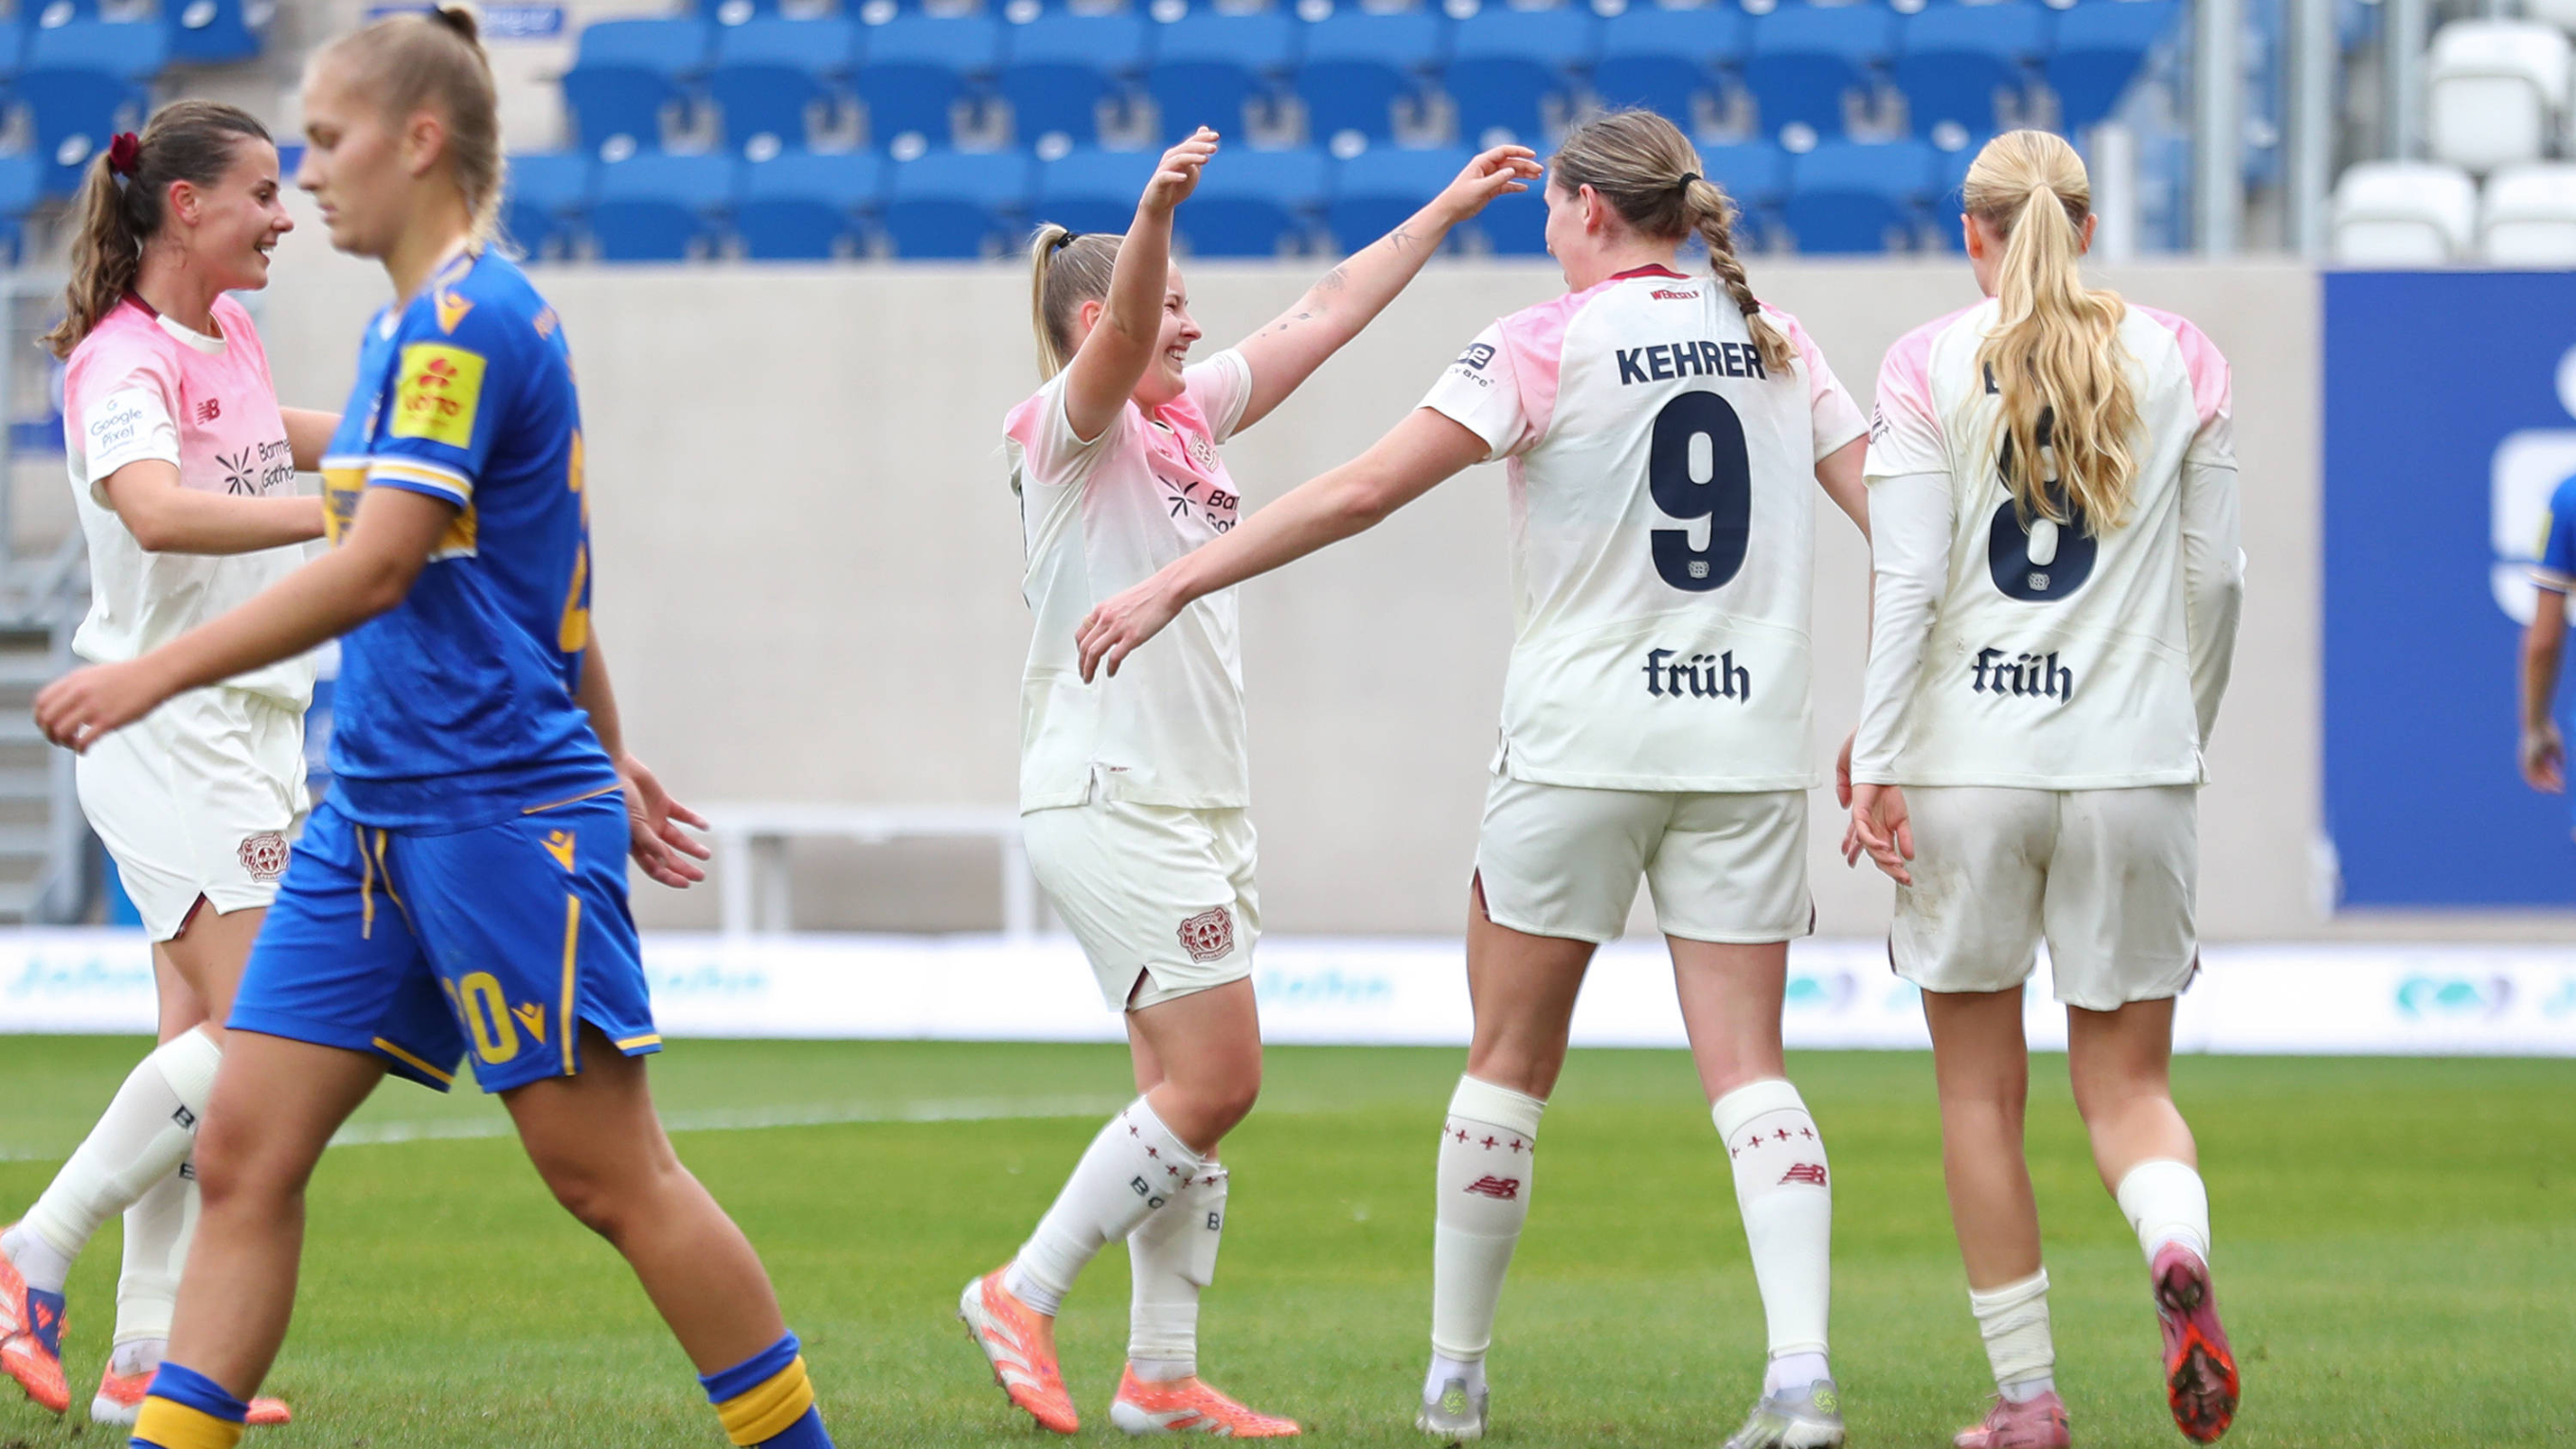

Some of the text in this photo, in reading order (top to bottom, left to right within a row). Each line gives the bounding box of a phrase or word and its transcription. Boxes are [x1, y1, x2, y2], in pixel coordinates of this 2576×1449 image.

[1616, 341, 1767, 385] KEHRER
[90, 408, 143, 436] Google
[1649, 390, 1750, 593] 9
